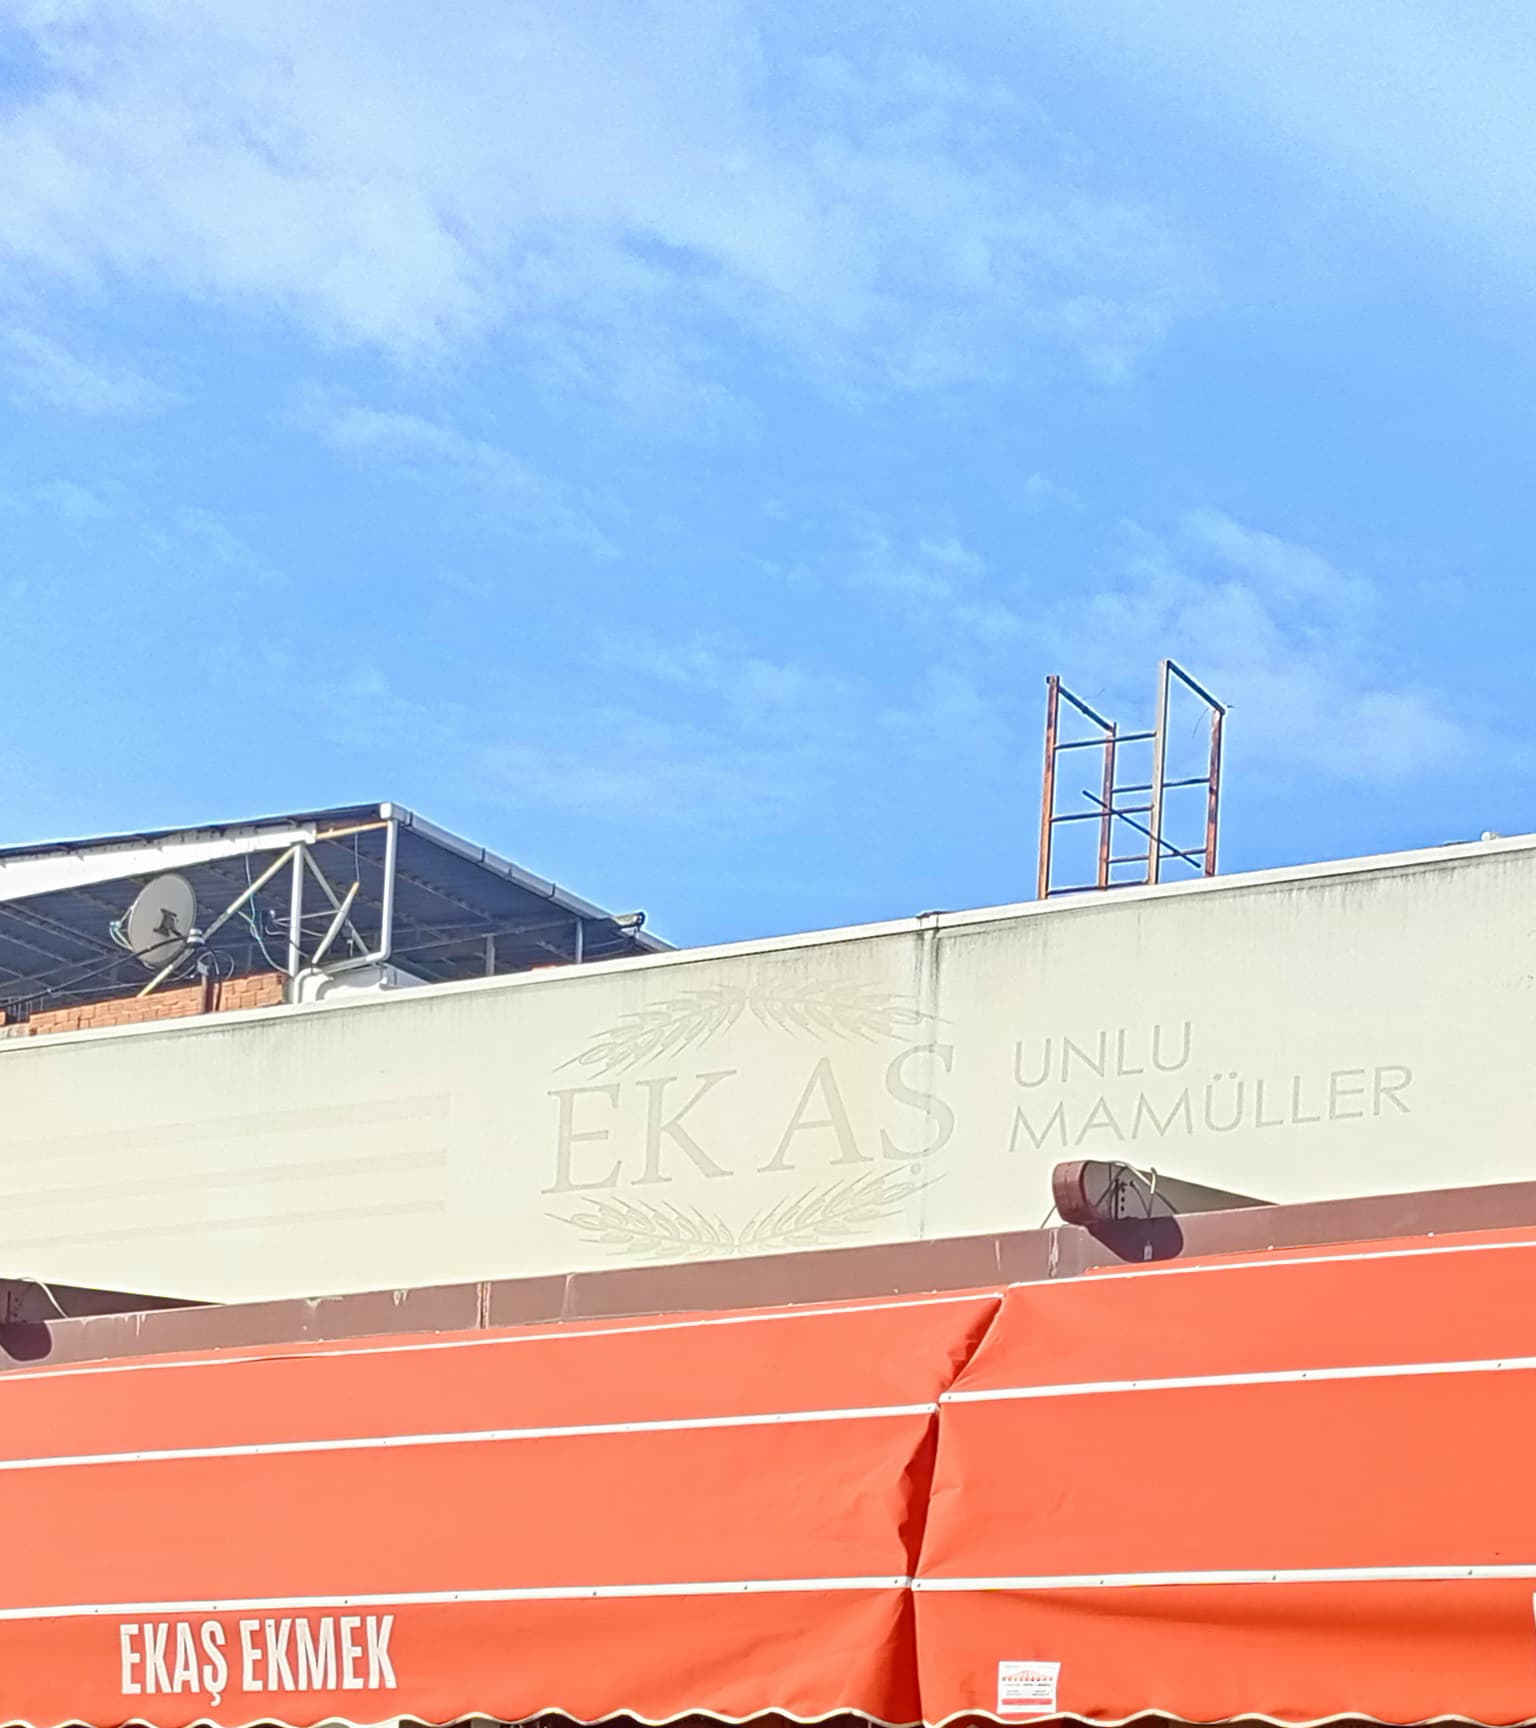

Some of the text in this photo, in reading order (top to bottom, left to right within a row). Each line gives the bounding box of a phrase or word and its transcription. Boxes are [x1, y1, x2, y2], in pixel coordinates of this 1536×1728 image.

[1013, 1021, 1192, 1088] UNLU
[1008, 1065, 1413, 1153] MAMÜLLER
[120, 1615, 397, 1707] EKAŞ EKMEK
